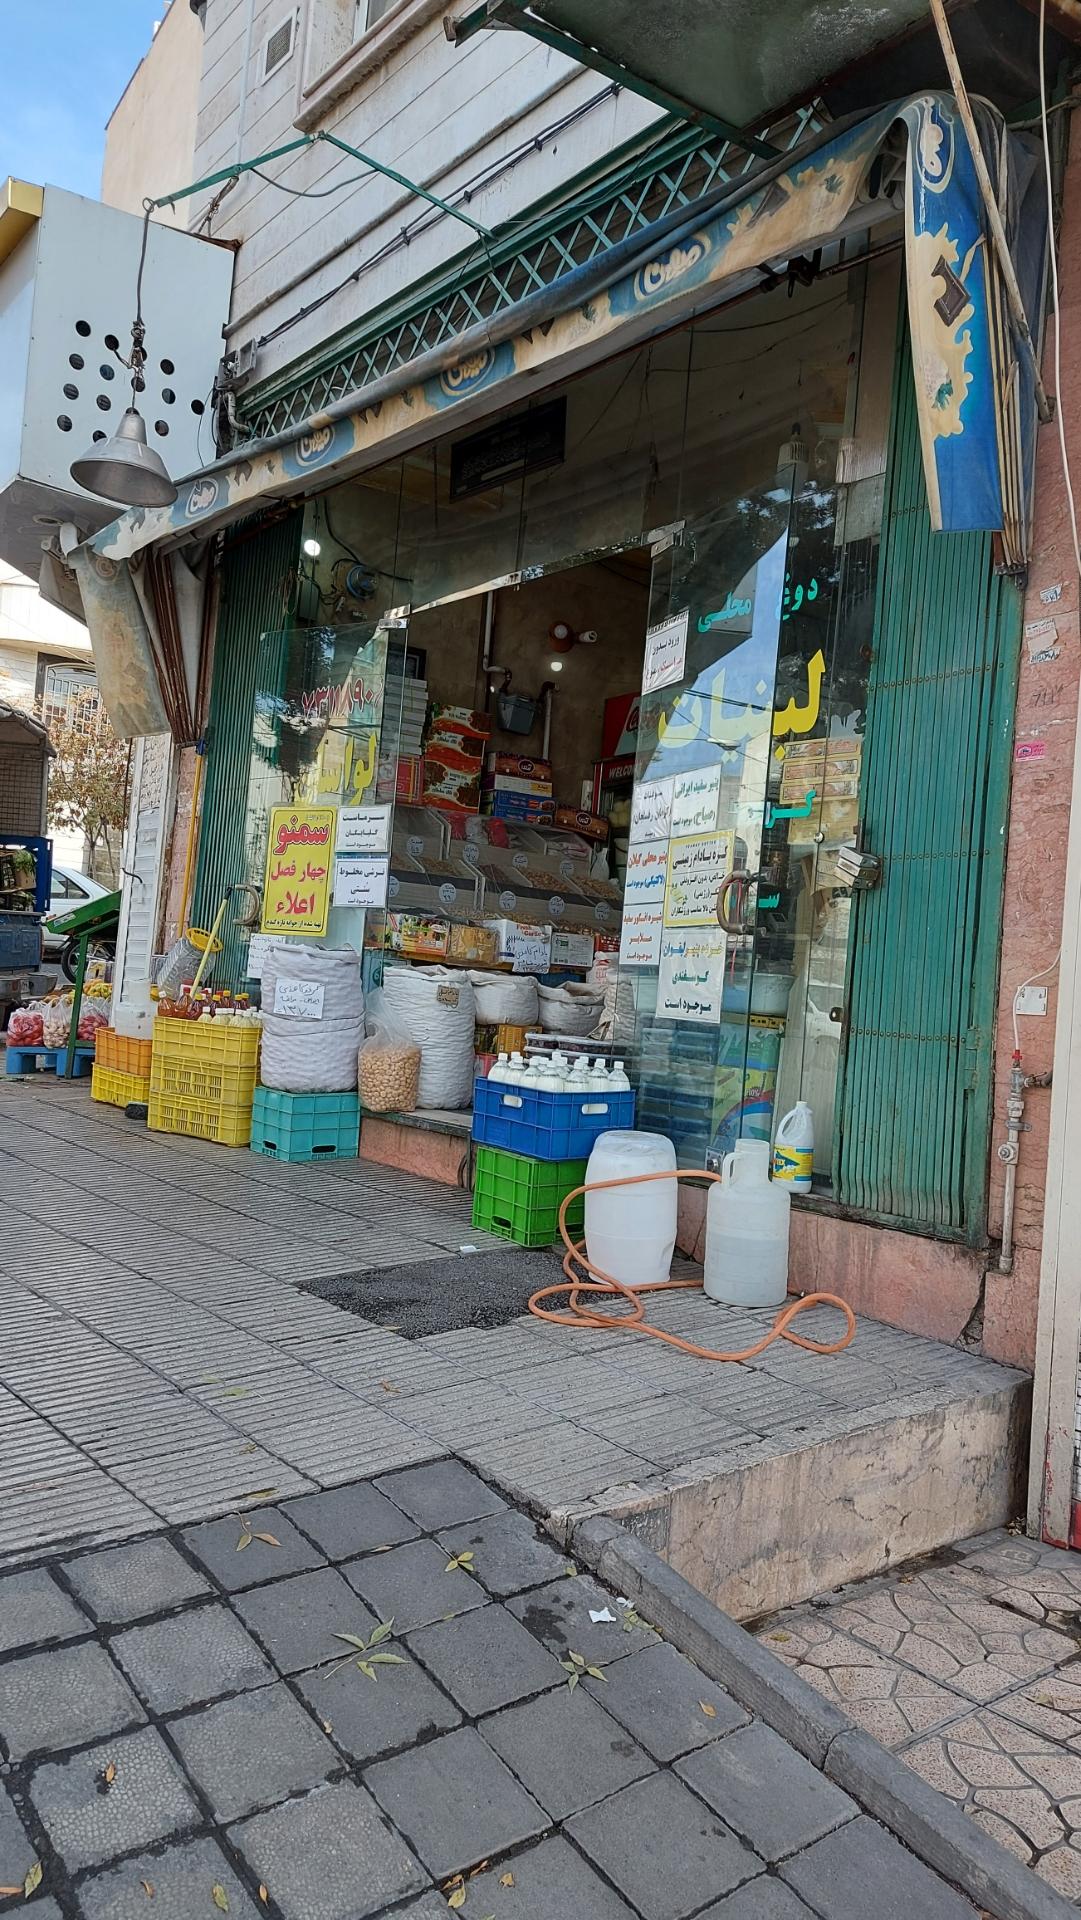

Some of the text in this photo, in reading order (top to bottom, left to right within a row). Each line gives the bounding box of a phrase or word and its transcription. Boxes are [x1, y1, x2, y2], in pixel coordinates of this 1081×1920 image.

[697, 591, 753, 633] محلی
[657, 648, 826, 762] لبنیات
[608, 765, 634, 778] WELCO
[272, 814, 330, 856] سمنو
[712, 845, 728, 865] کره
[270, 859, 326, 884] چهار فصل
[275, 890, 315, 915] اعلاء
[671, 968, 710, 986] گوسفندی
[664, 996, 713, 1015] موجود است
